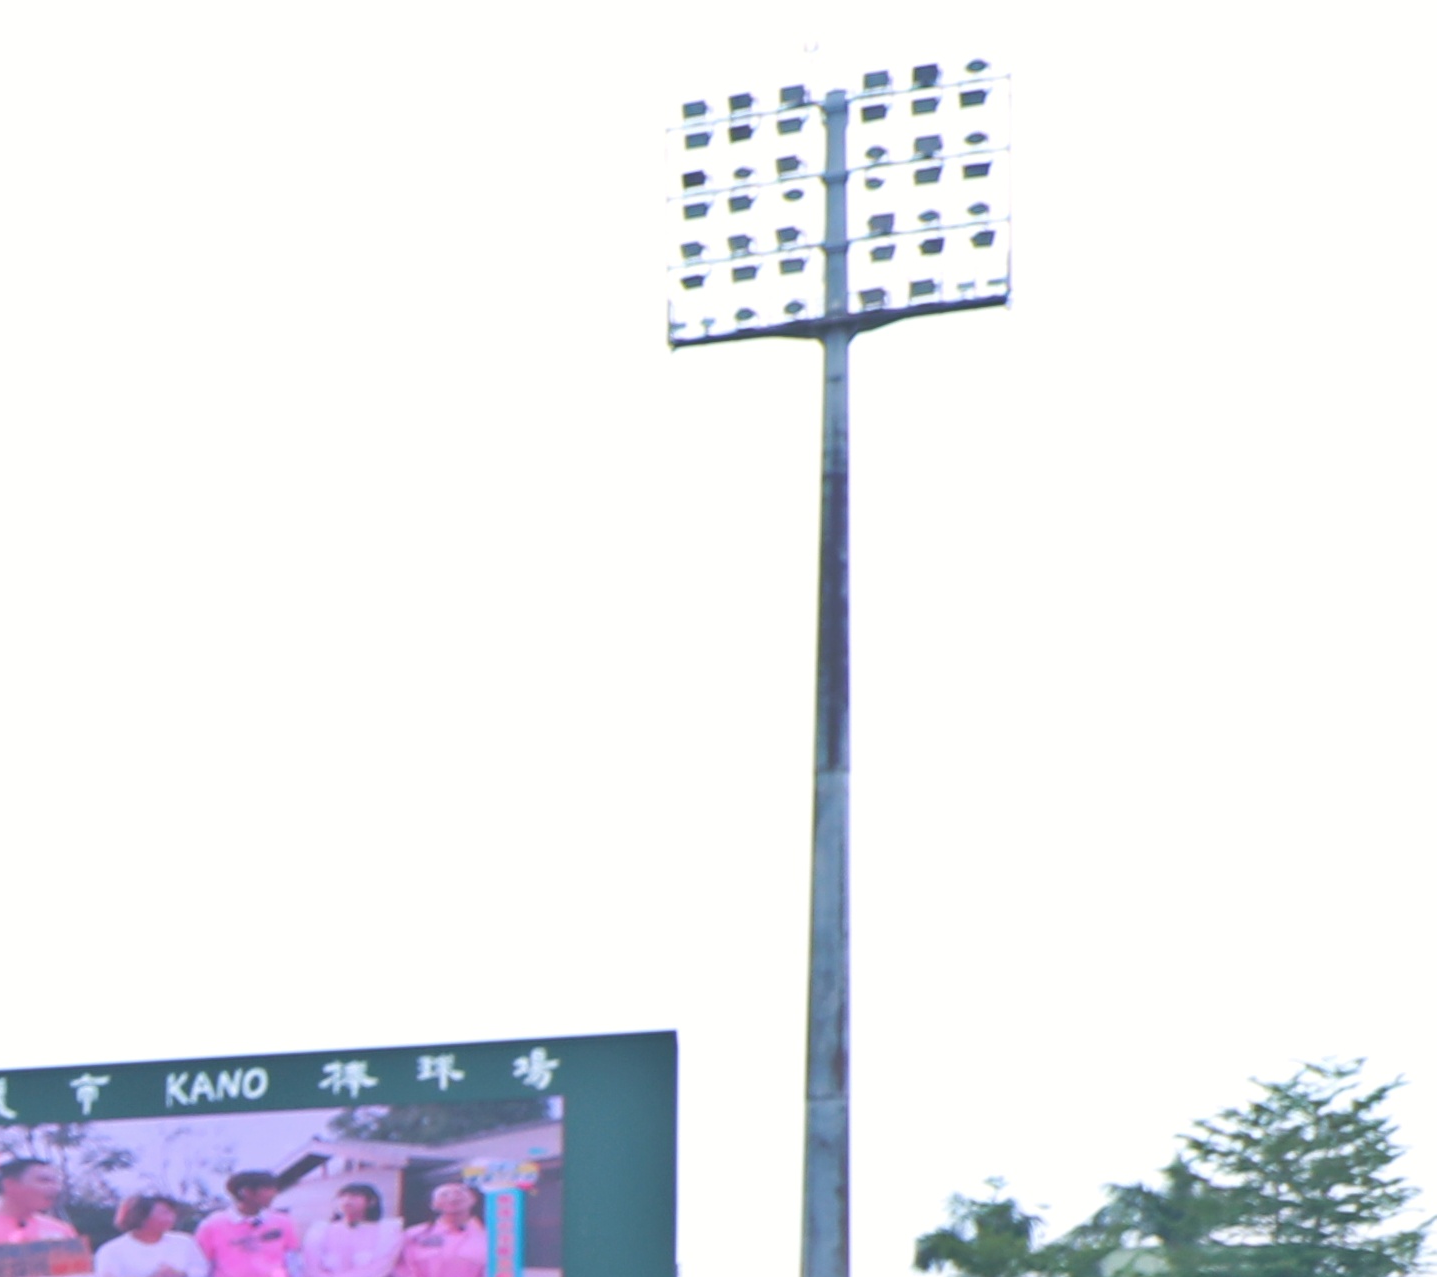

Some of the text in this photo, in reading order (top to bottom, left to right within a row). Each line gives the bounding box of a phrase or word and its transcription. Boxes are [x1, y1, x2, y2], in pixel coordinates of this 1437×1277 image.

[165, 1067, 269, 1107] KANO
[318, 1047, 560, 1098] 棒球場
